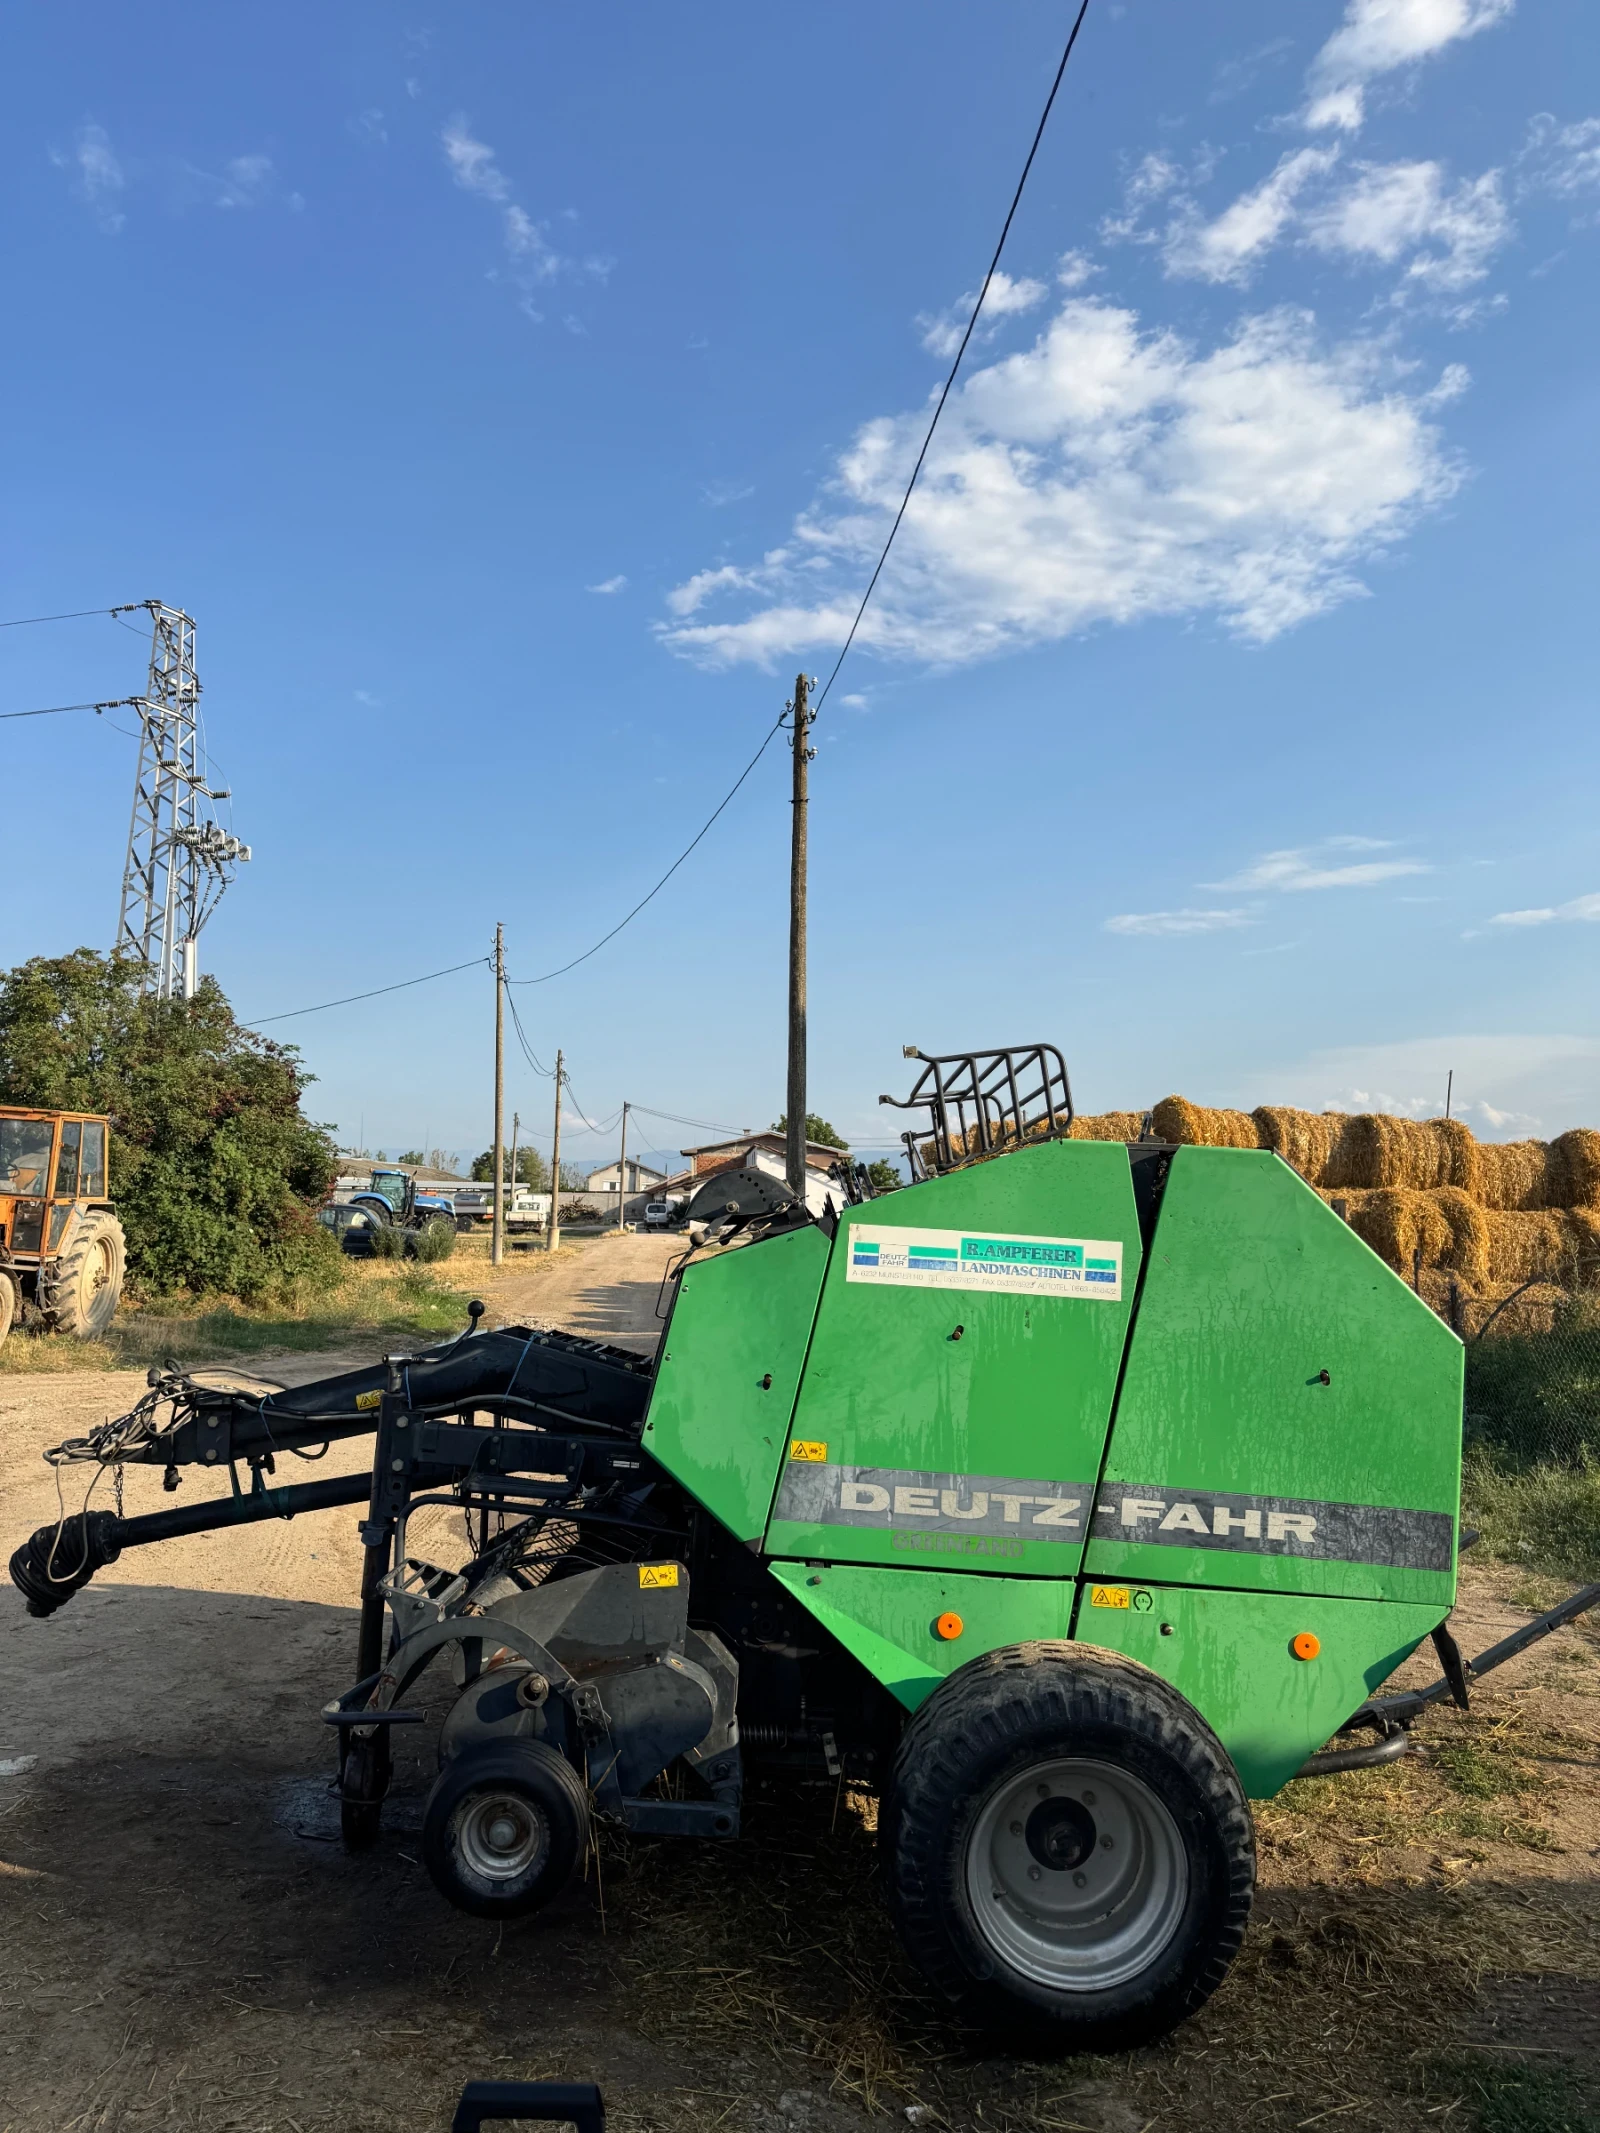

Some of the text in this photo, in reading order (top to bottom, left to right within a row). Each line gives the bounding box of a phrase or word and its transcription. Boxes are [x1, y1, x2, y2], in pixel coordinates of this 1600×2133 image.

[880, 1253, 908, 1261] DEUTZ
[961, 1262, 1082, 1280] LANDMASCHINEN
[893, 1531, 1024, 1558] GREENLAND
